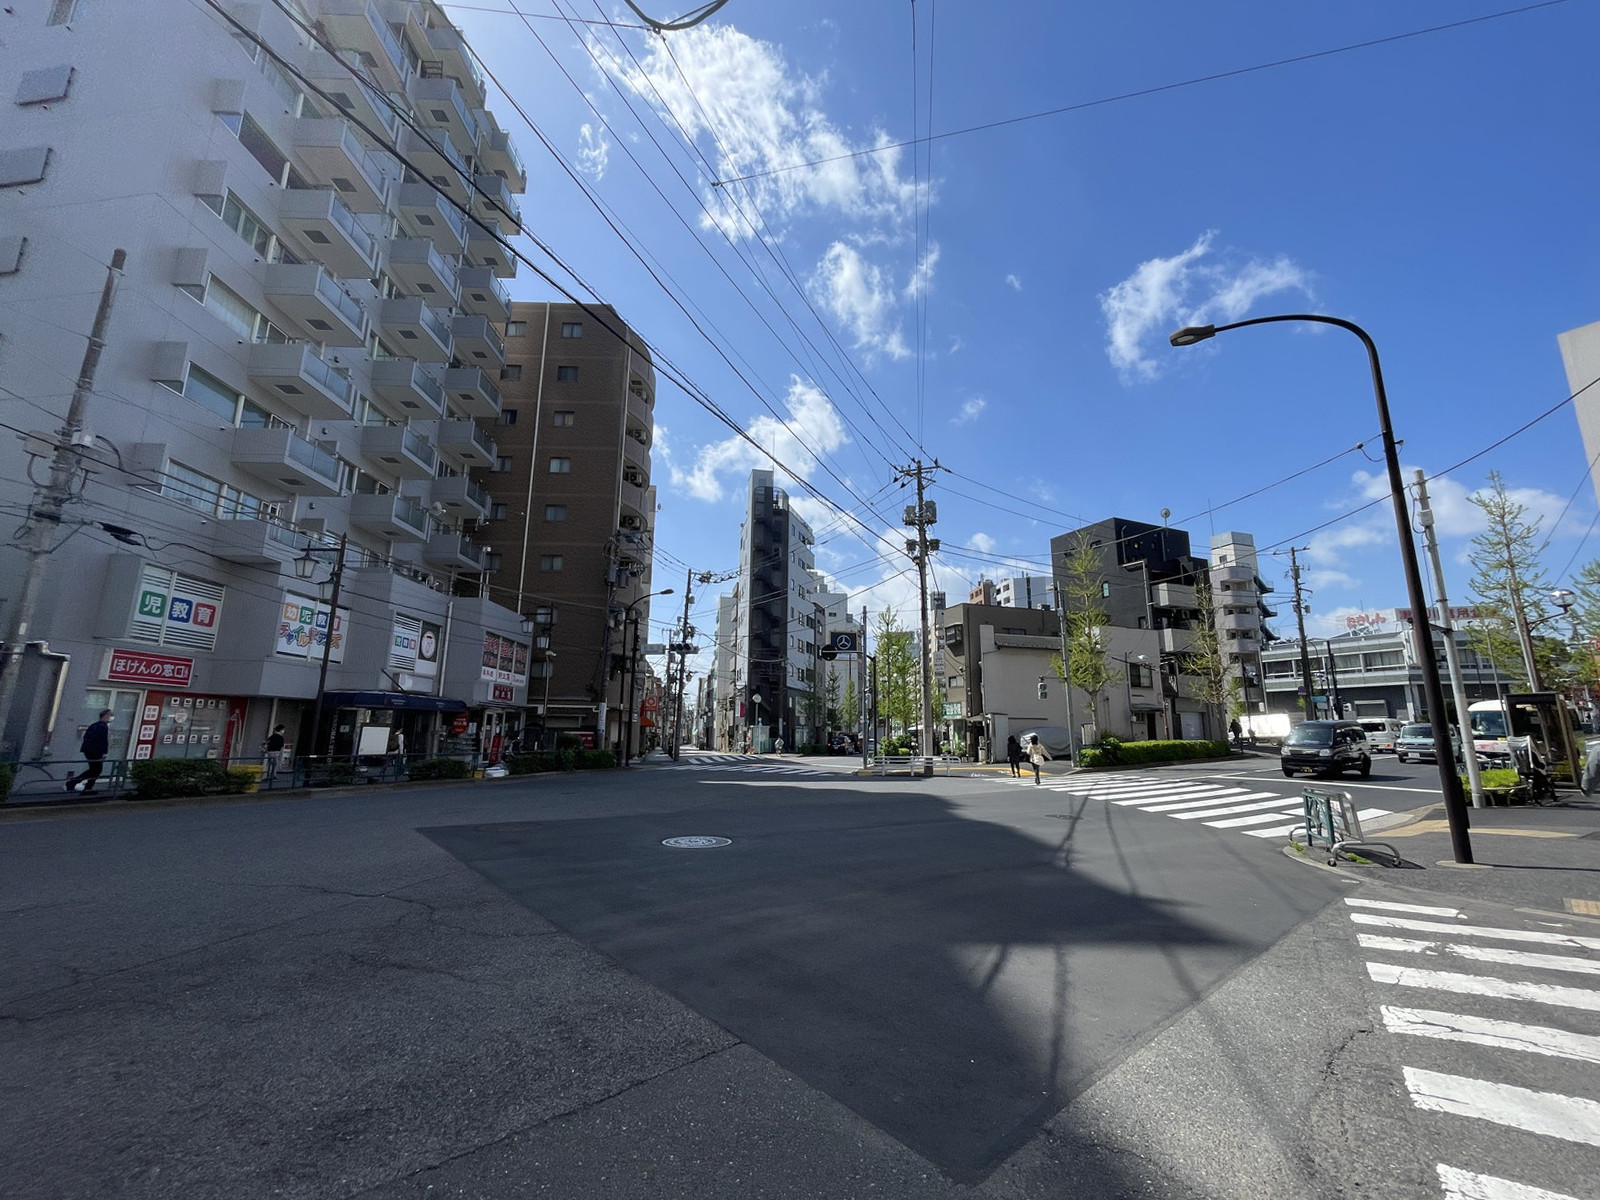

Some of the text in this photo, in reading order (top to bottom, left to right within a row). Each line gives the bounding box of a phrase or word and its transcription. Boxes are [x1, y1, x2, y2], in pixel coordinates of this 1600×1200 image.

[143, 594, 213, 623] 児教育
[113, 659, 184, 677] ほけんの窓口
